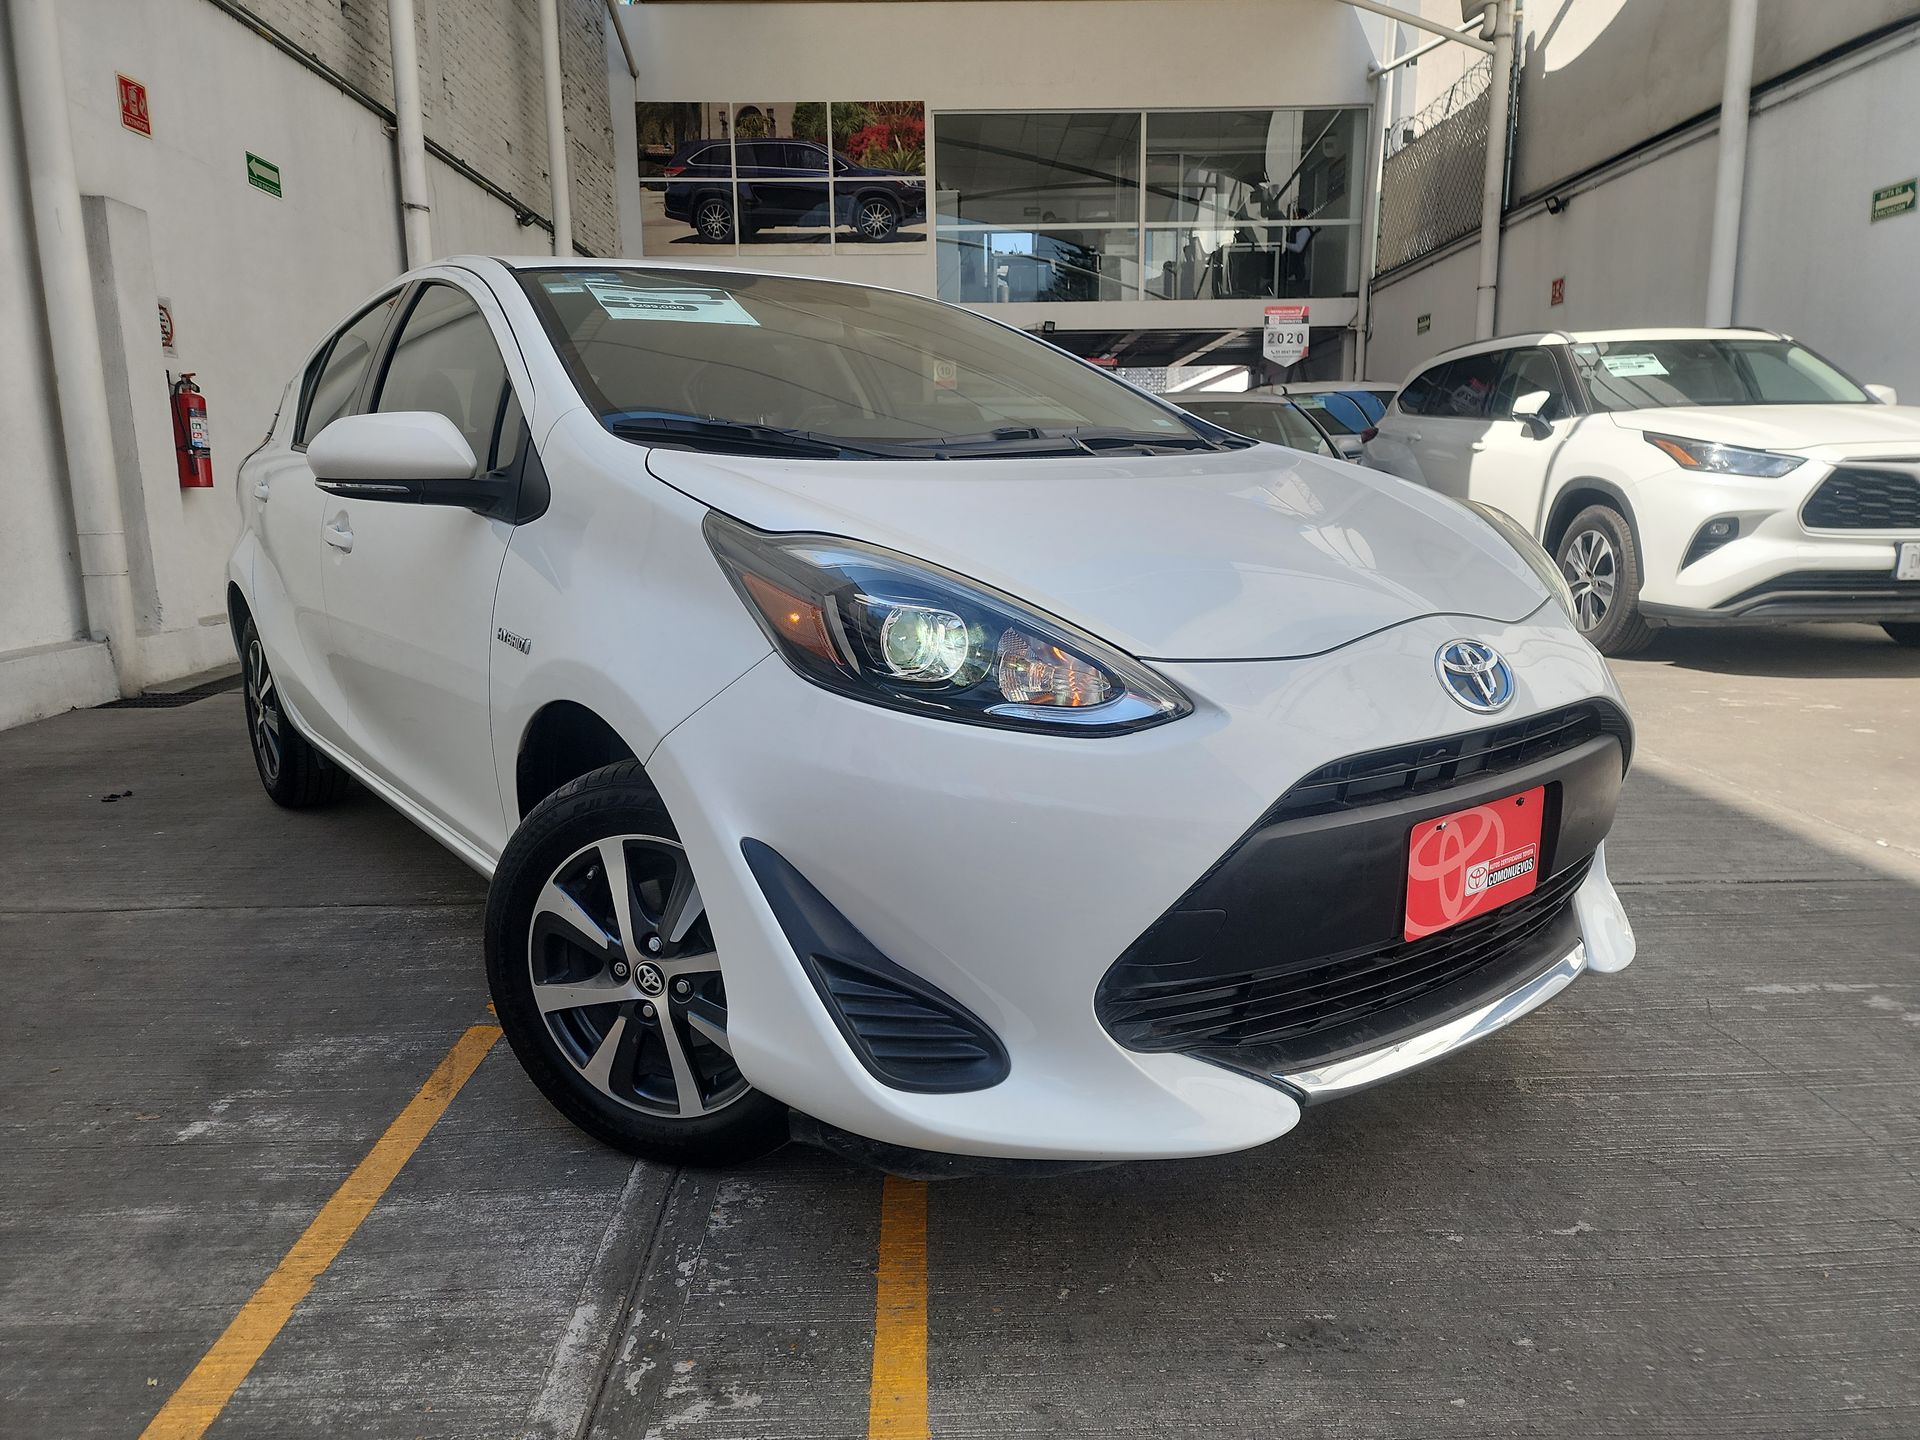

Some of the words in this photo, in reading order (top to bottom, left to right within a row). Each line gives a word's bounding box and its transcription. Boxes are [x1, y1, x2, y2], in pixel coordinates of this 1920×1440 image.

[1267, 332, 1304, 344] 2020
[497, 627, 525, 651] HYBRID
[1488, 857, 1533, 886] COMONUEVOS
